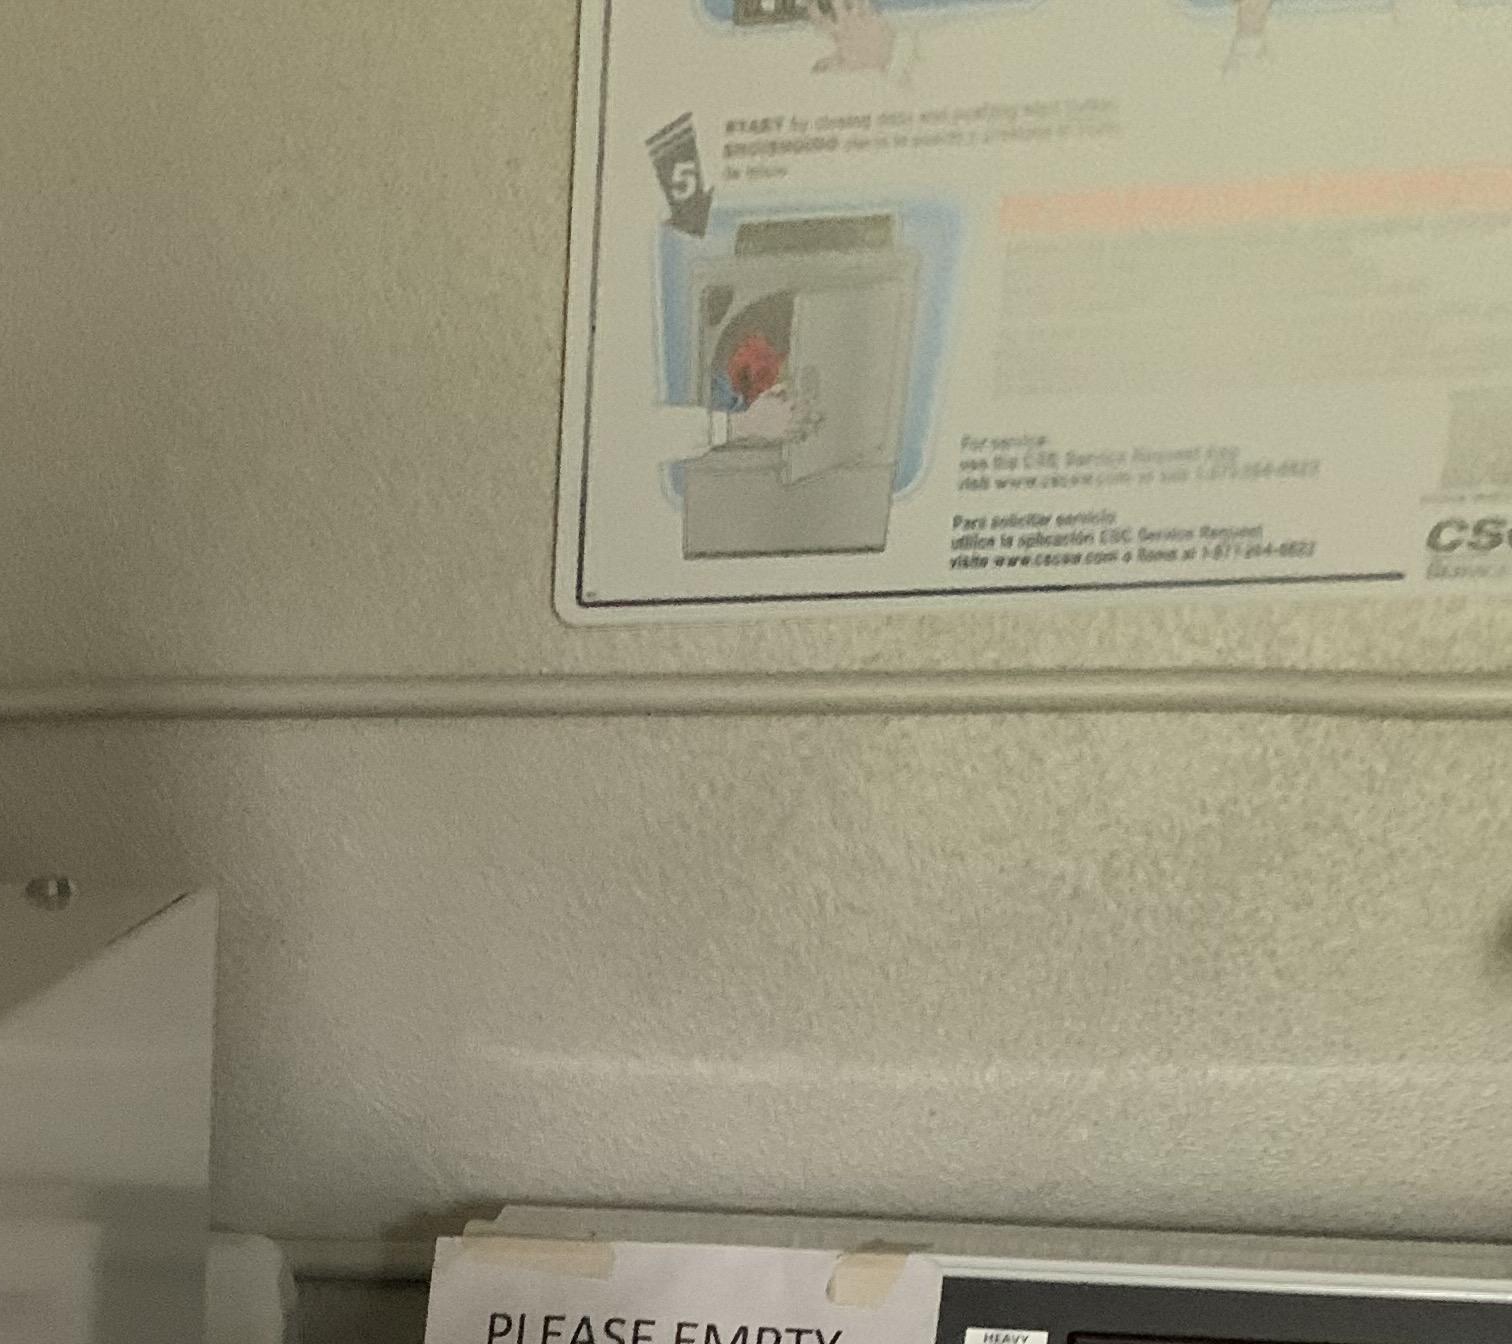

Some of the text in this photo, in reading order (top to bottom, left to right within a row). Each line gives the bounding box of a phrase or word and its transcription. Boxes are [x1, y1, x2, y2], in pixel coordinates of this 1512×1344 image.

[672, 163, 696, 200] 5
[1426, 515, 1512, 552] CS
[984, 1332, 1030, 1344] HEAVY
